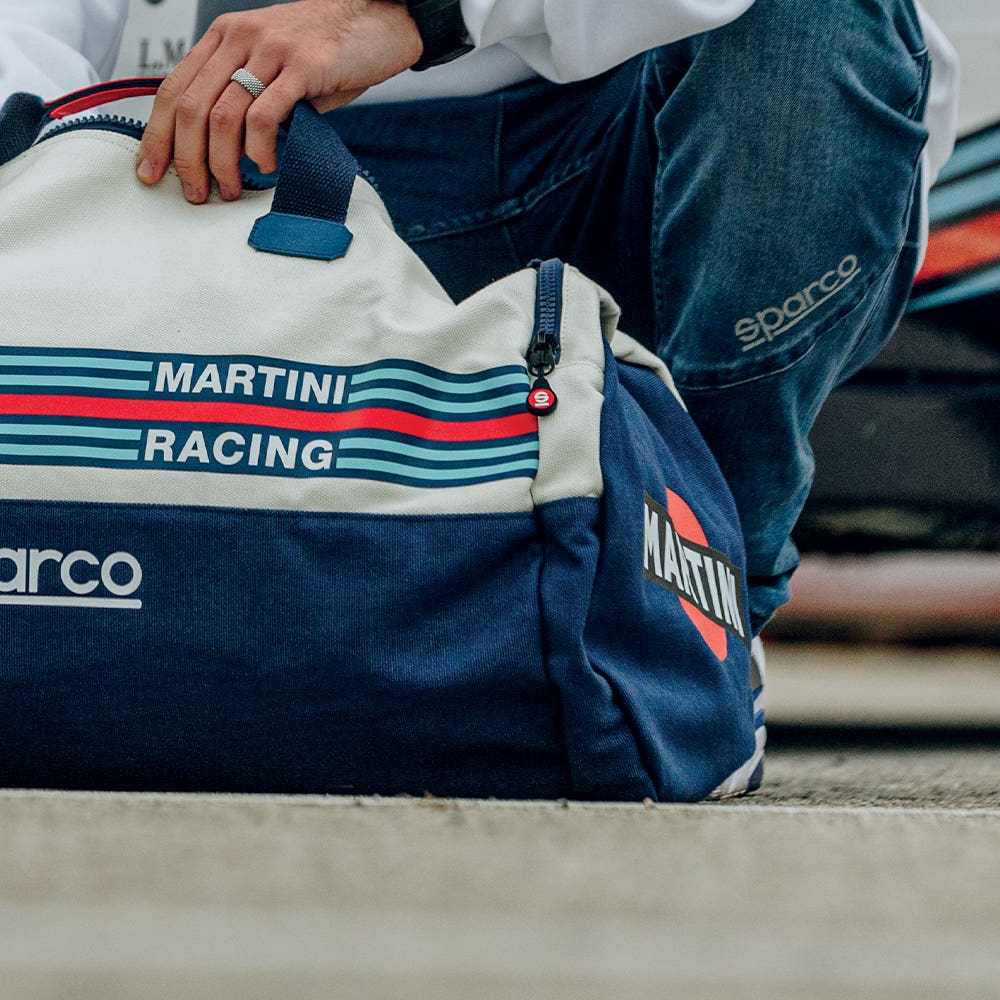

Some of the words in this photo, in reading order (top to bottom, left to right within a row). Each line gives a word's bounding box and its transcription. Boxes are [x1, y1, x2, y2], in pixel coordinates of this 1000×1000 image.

[735, 254, 861, 352] sparco
[154, 361, 347, 405] MARTINI
[144, 428, 334, 471] RACING
